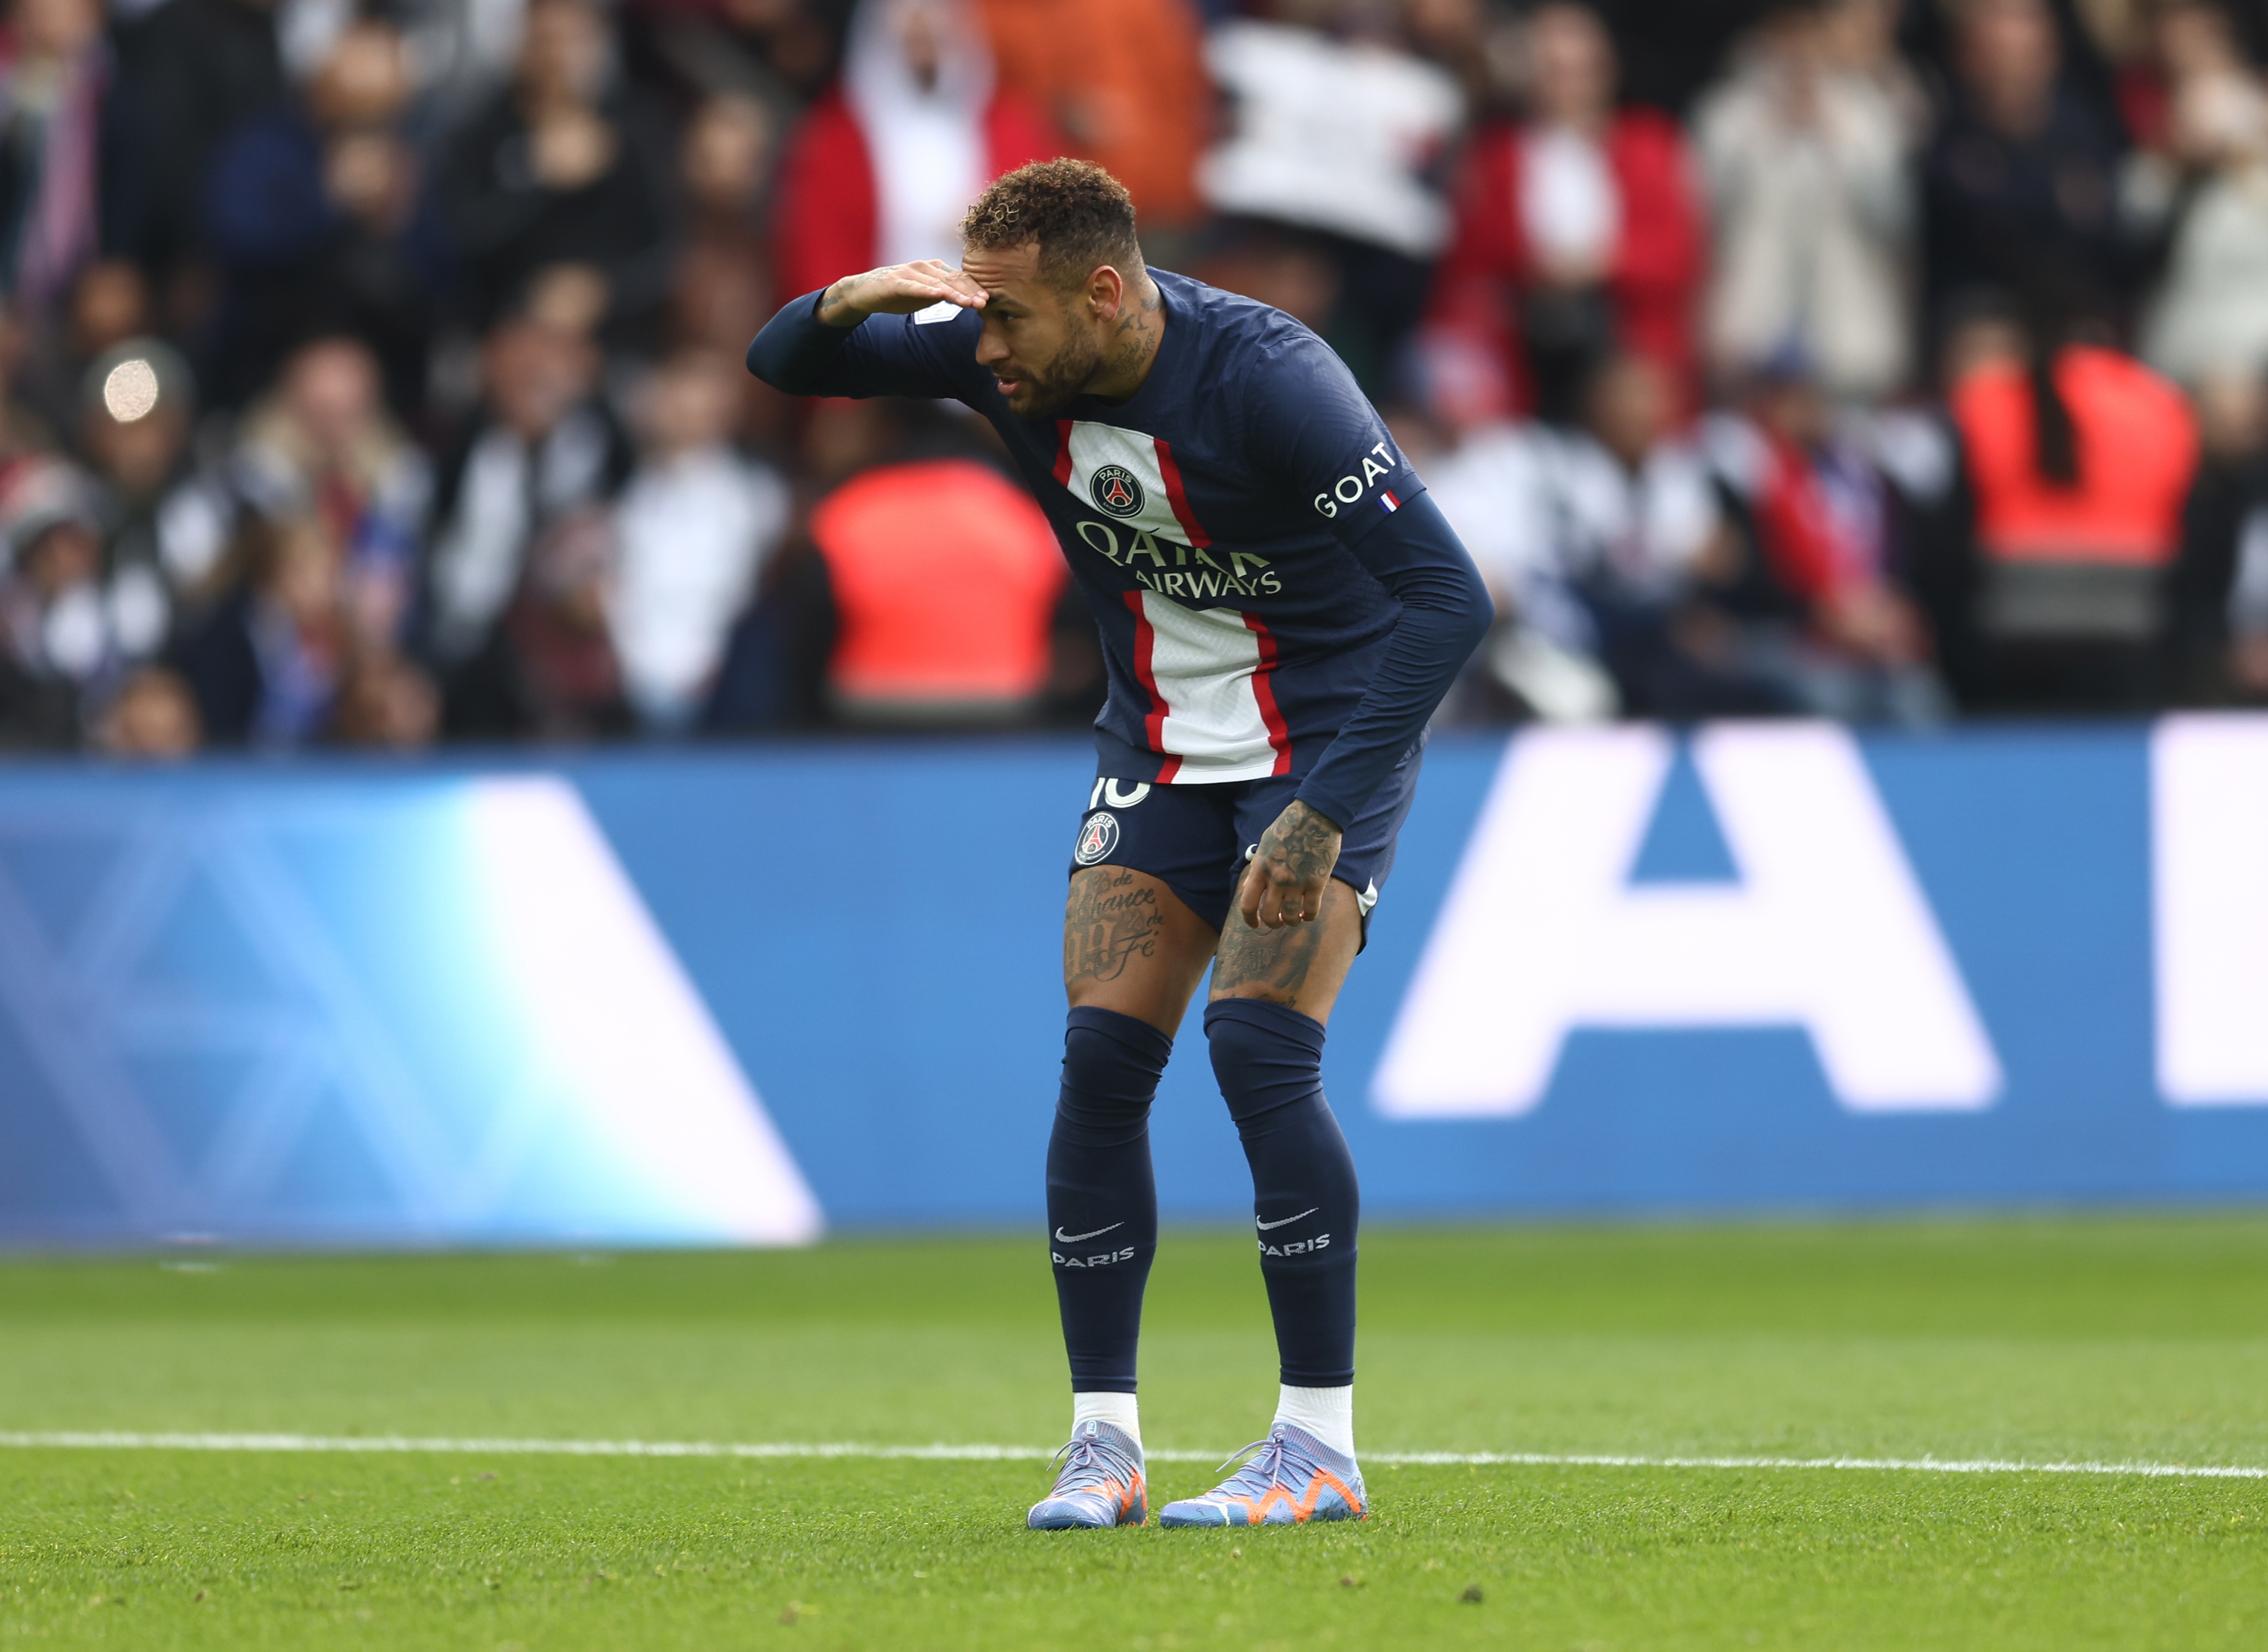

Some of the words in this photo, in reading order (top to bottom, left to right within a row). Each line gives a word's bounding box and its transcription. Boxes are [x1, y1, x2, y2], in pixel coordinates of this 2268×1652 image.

[1099, 469, 1133, 483] PARIS
[1314, 441, 1396, 519] GOAT
[1136, 570, 1282, 599] AIRWAYS
[1087, 815, 1114, 829] PARIS
[1113, 868, 1134, 887] de
[1258, 1234, 1330, 1257] PARIS
[1052, 1246, 1134, 1268] PARIS
